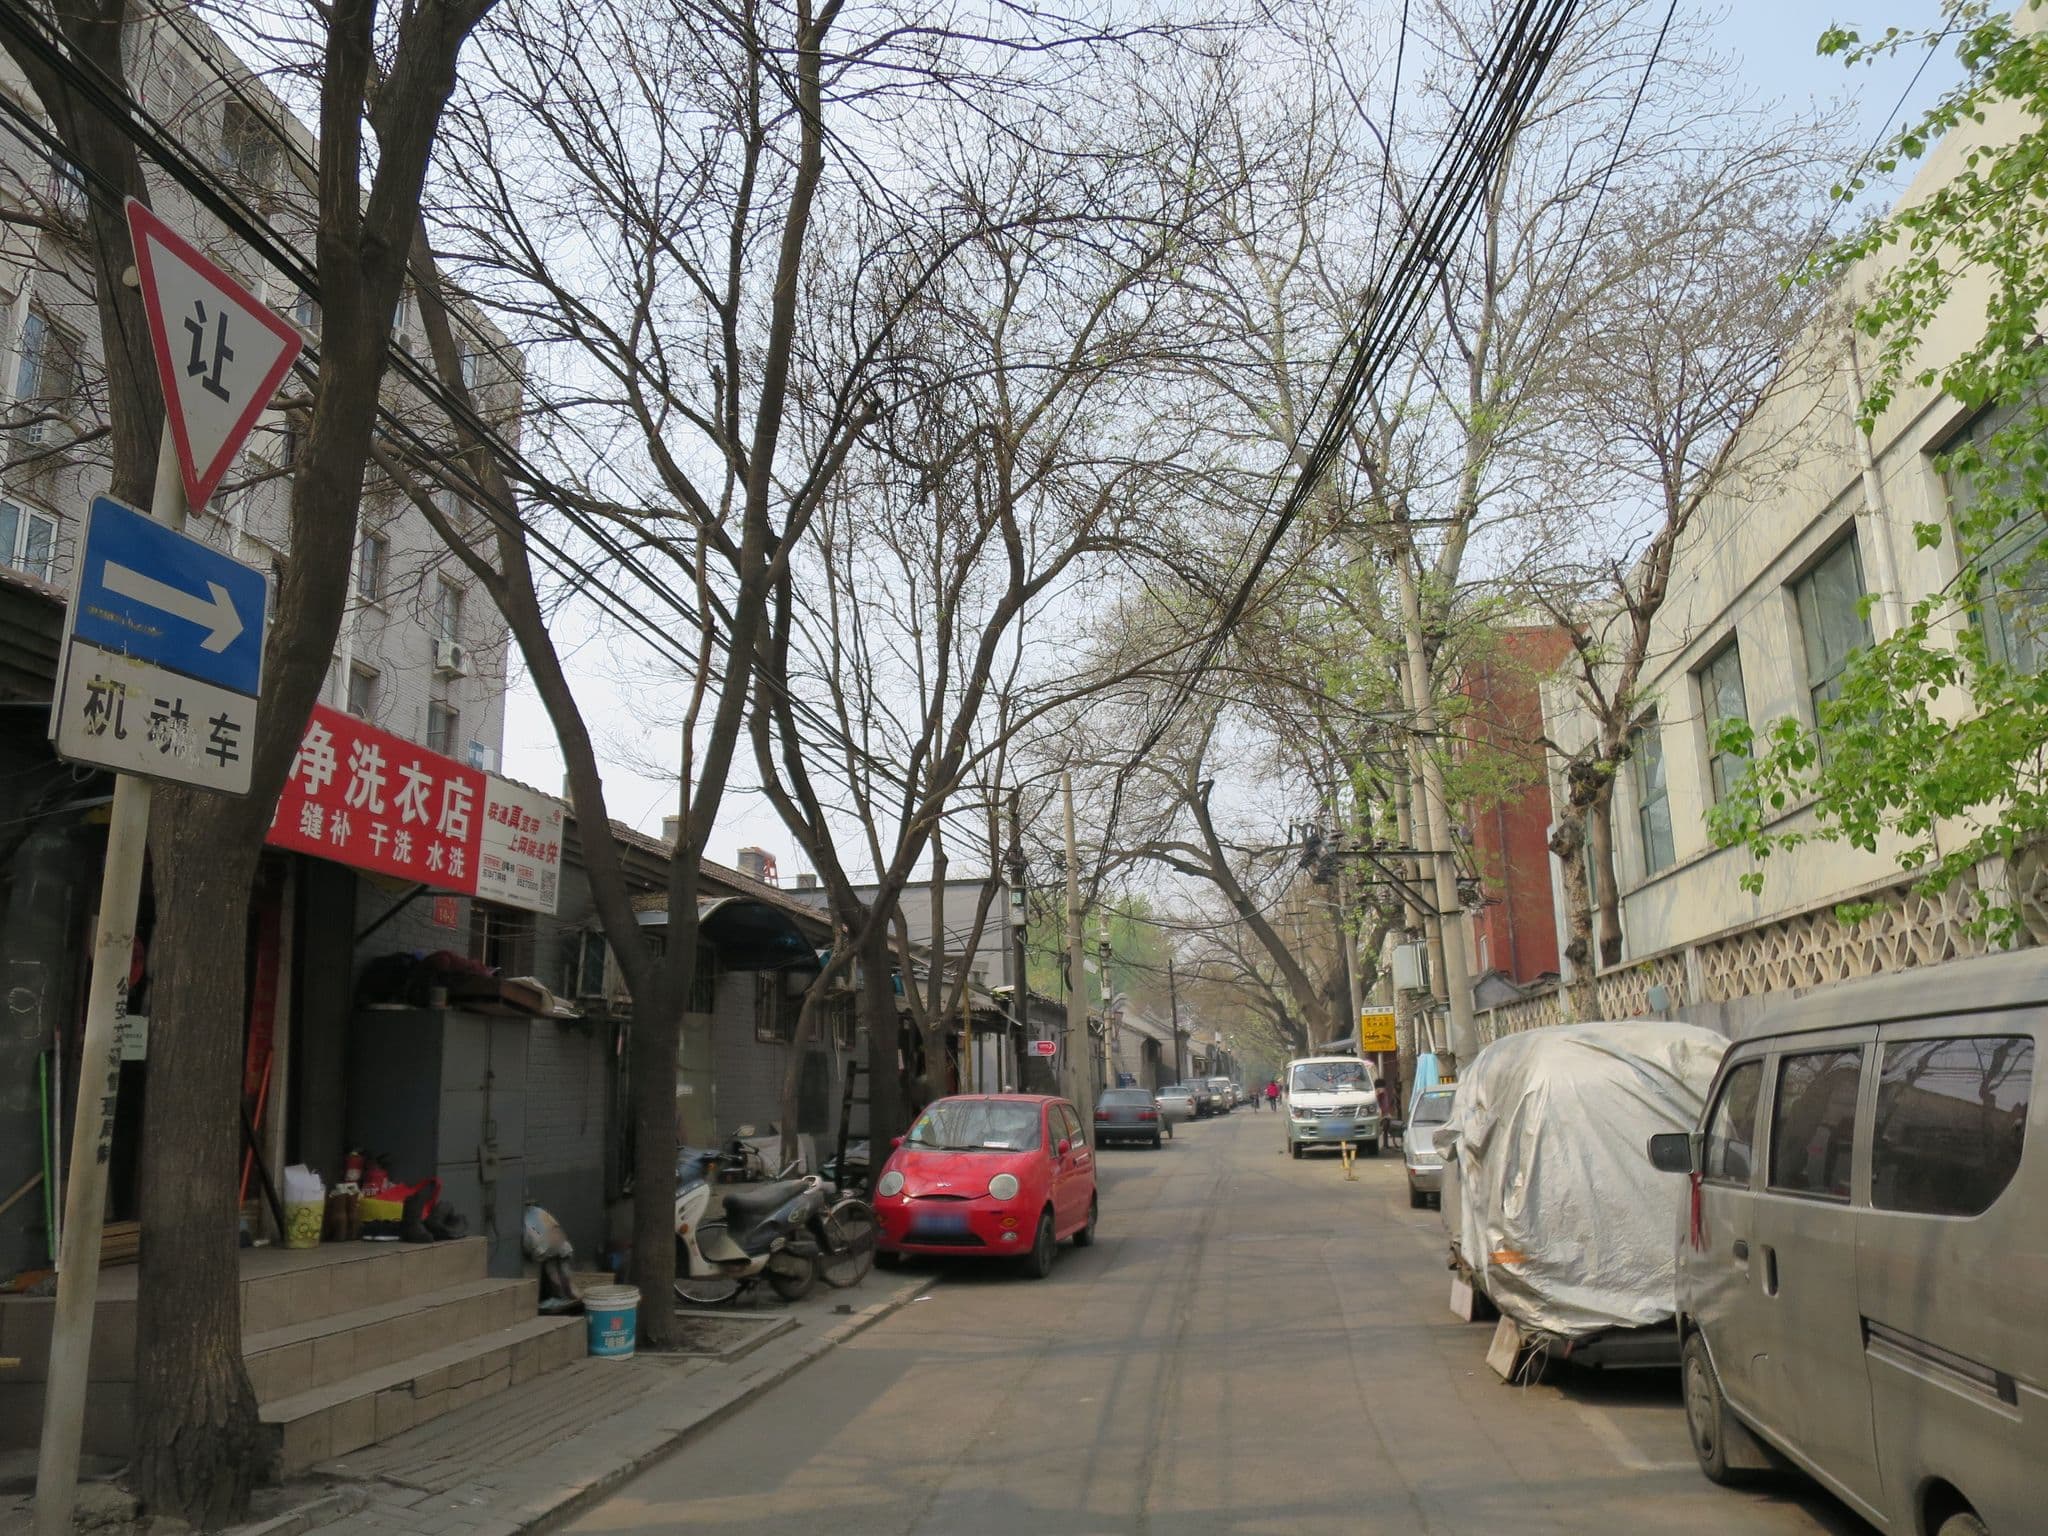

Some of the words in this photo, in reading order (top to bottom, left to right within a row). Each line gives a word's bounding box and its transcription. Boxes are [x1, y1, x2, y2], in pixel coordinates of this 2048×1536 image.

[184, 300, 234, 404] 让
[83, 674, 241, 768] 机动车
[289, 720, 473, 843] 净洗衣店
[299, 801, 352, 847] 缝补
[368, 822, 413, 864] 干洗
[426, 840, 466, 878] 水洗
